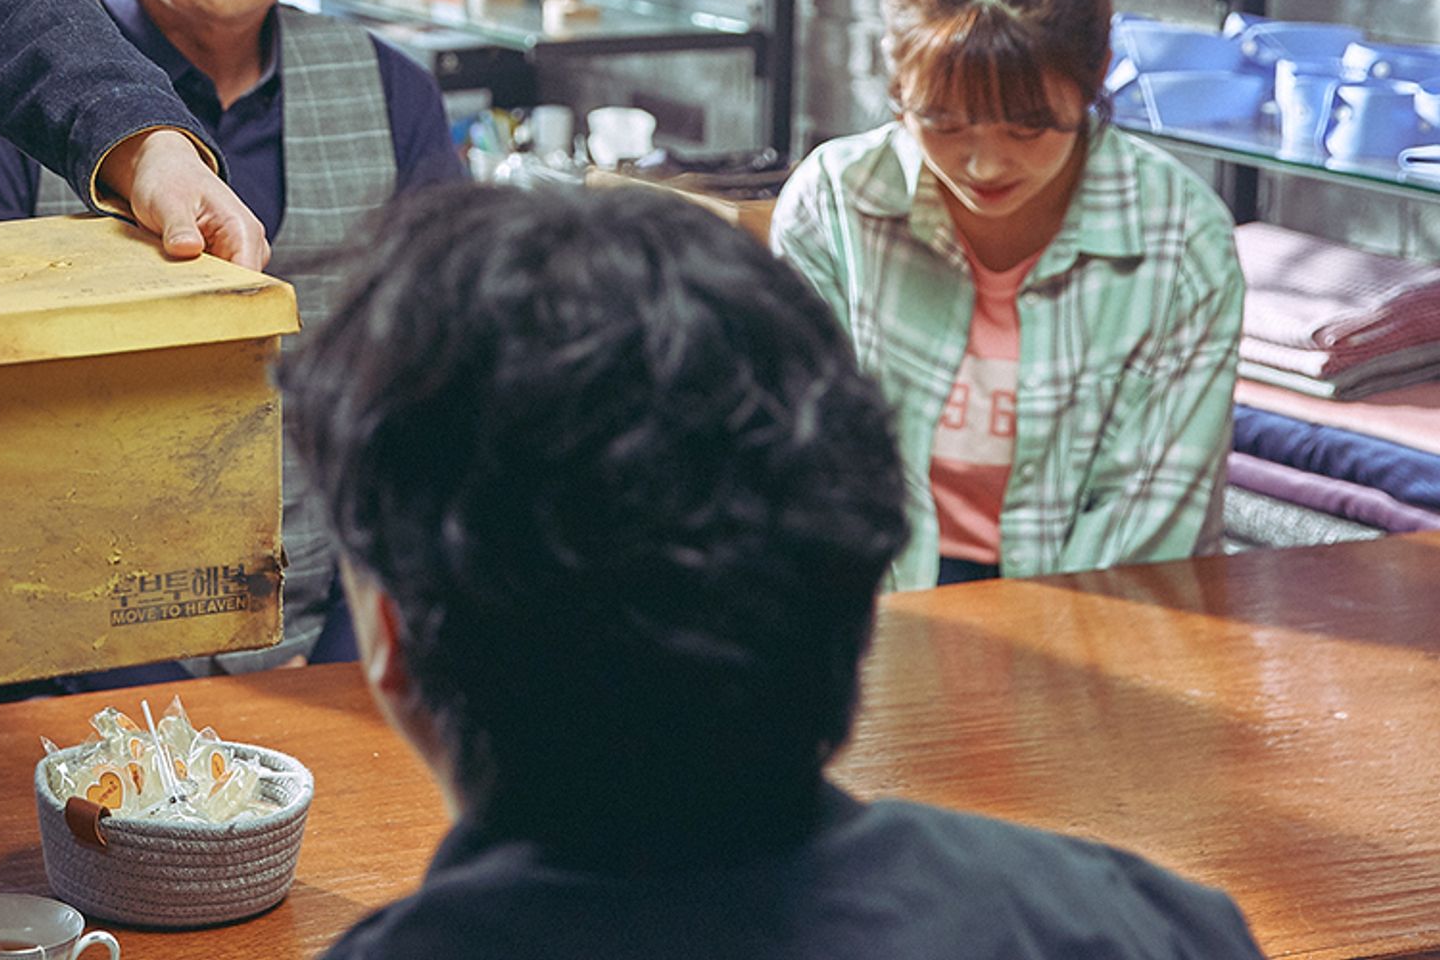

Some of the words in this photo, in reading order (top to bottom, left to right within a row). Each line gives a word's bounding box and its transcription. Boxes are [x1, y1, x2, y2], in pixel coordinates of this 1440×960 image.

[112, 607, 159, 625] MOVE
[161, 603, 182, 619] TO
[185, 595, 247, 616] HEAVEN
